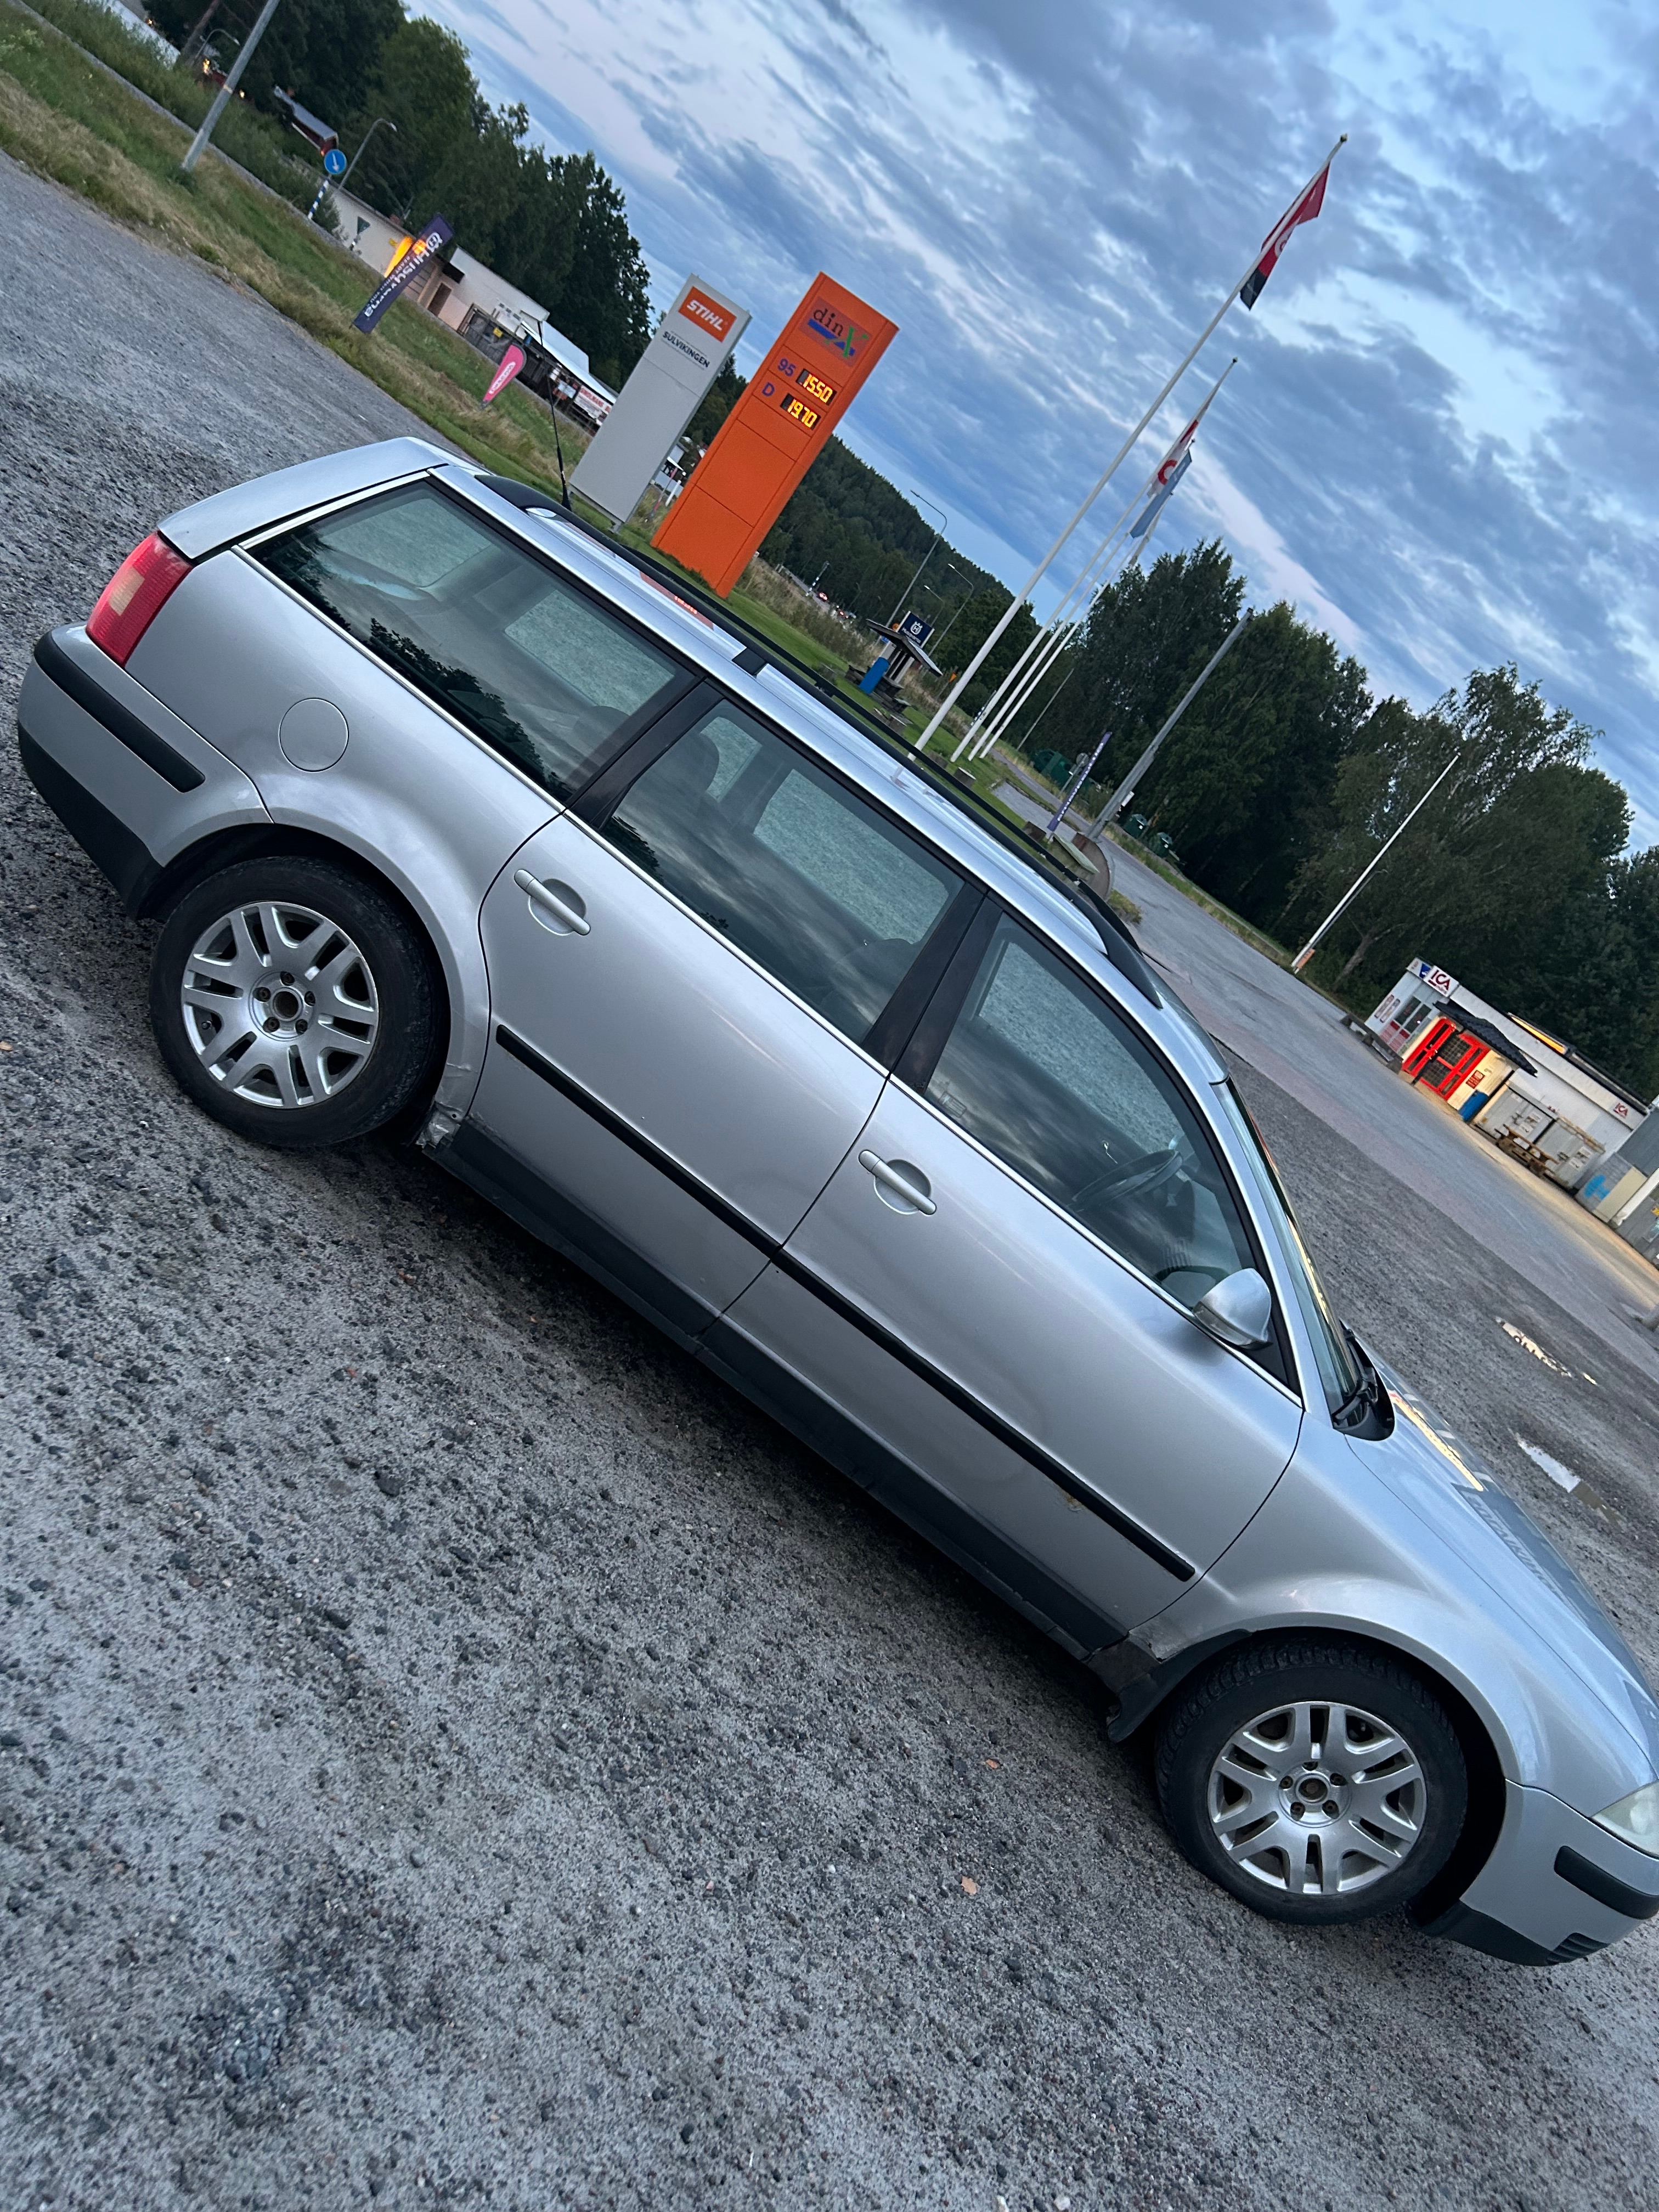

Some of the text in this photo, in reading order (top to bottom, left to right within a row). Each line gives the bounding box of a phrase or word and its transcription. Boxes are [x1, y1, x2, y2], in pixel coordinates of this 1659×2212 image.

[687, 300, 724, 331] STIHL
[663, 331, 710, 368] SULVIKINGEN
[777, 358, 833, 403] 95 1550
[762, 382, 817, 428] D 1970
[1431, 969, 1450, 990] ICA
[1615, 1103, 1628, 1116] ICA
